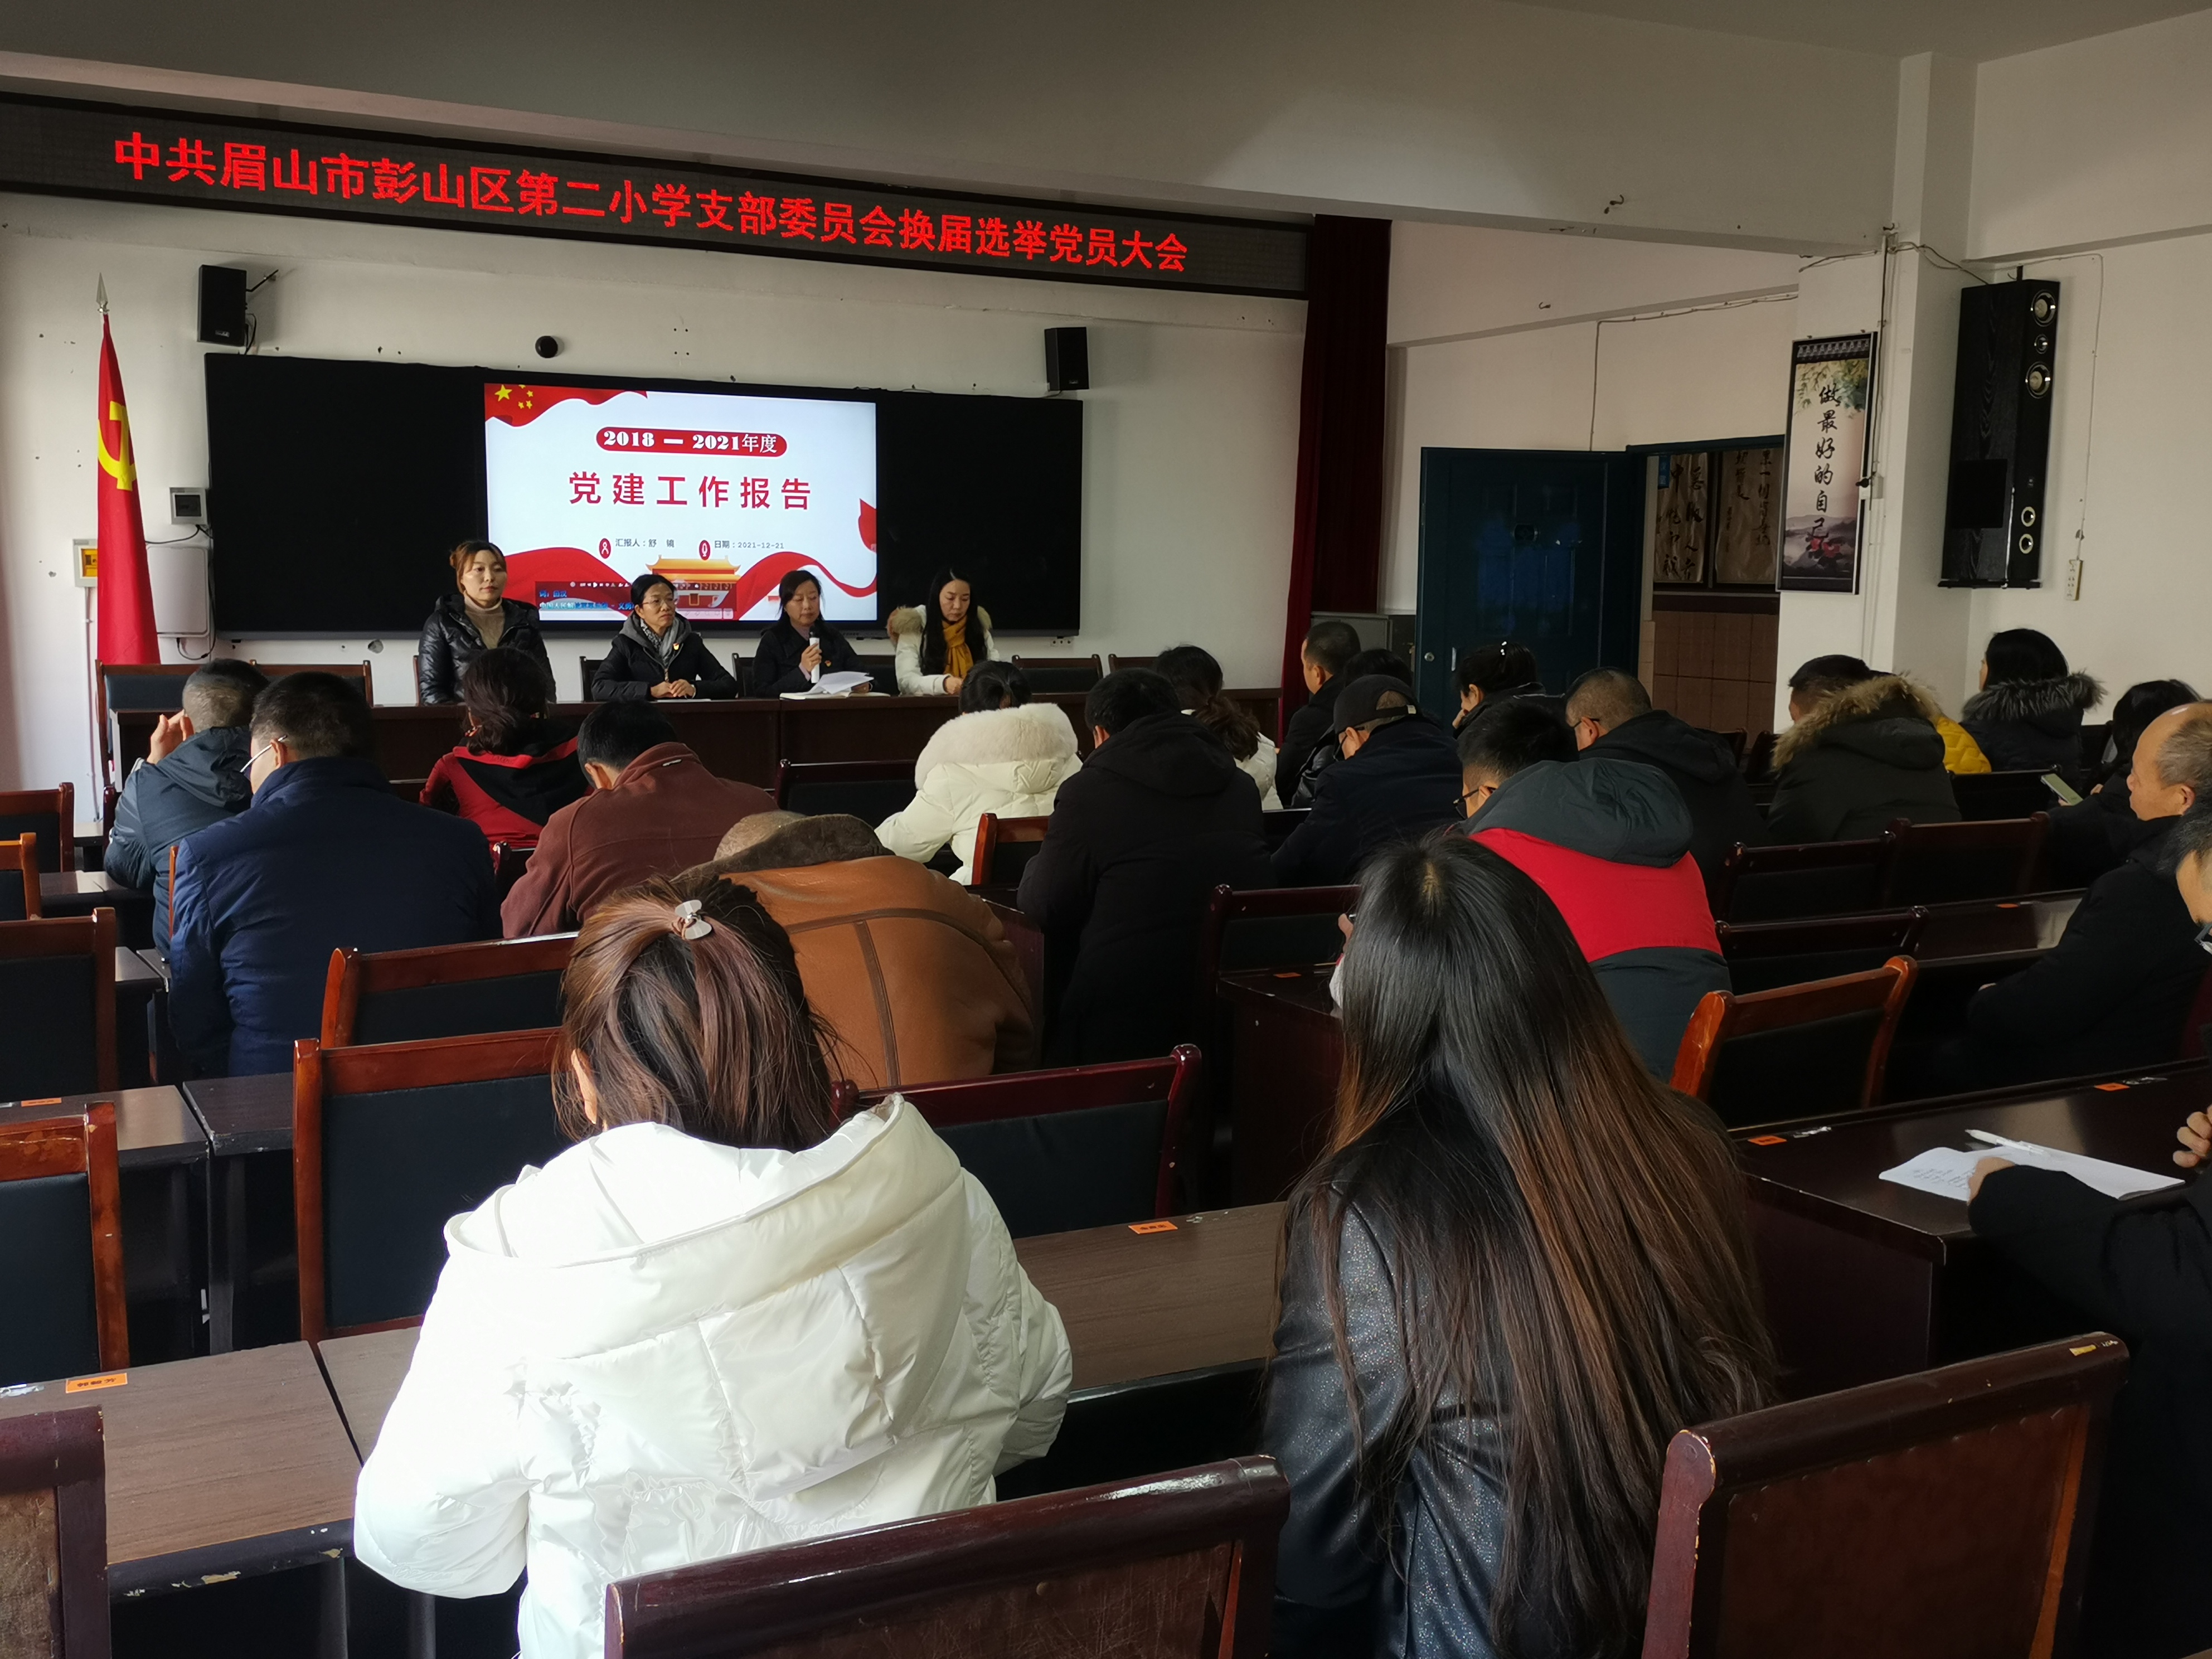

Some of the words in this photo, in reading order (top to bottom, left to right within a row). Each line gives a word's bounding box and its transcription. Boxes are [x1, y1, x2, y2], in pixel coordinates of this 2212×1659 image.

[114, 132, 1188, 272] 中共眉山市彭山区第二小学支部委员会换届选举党员大会
[604, 430, 655, 447] 2018
[692, 433, 777, 454] 2021年度
[1810, 384, 1841, 539] 做最好的自己
[569, 471, 811, 510] 党建工作报告
